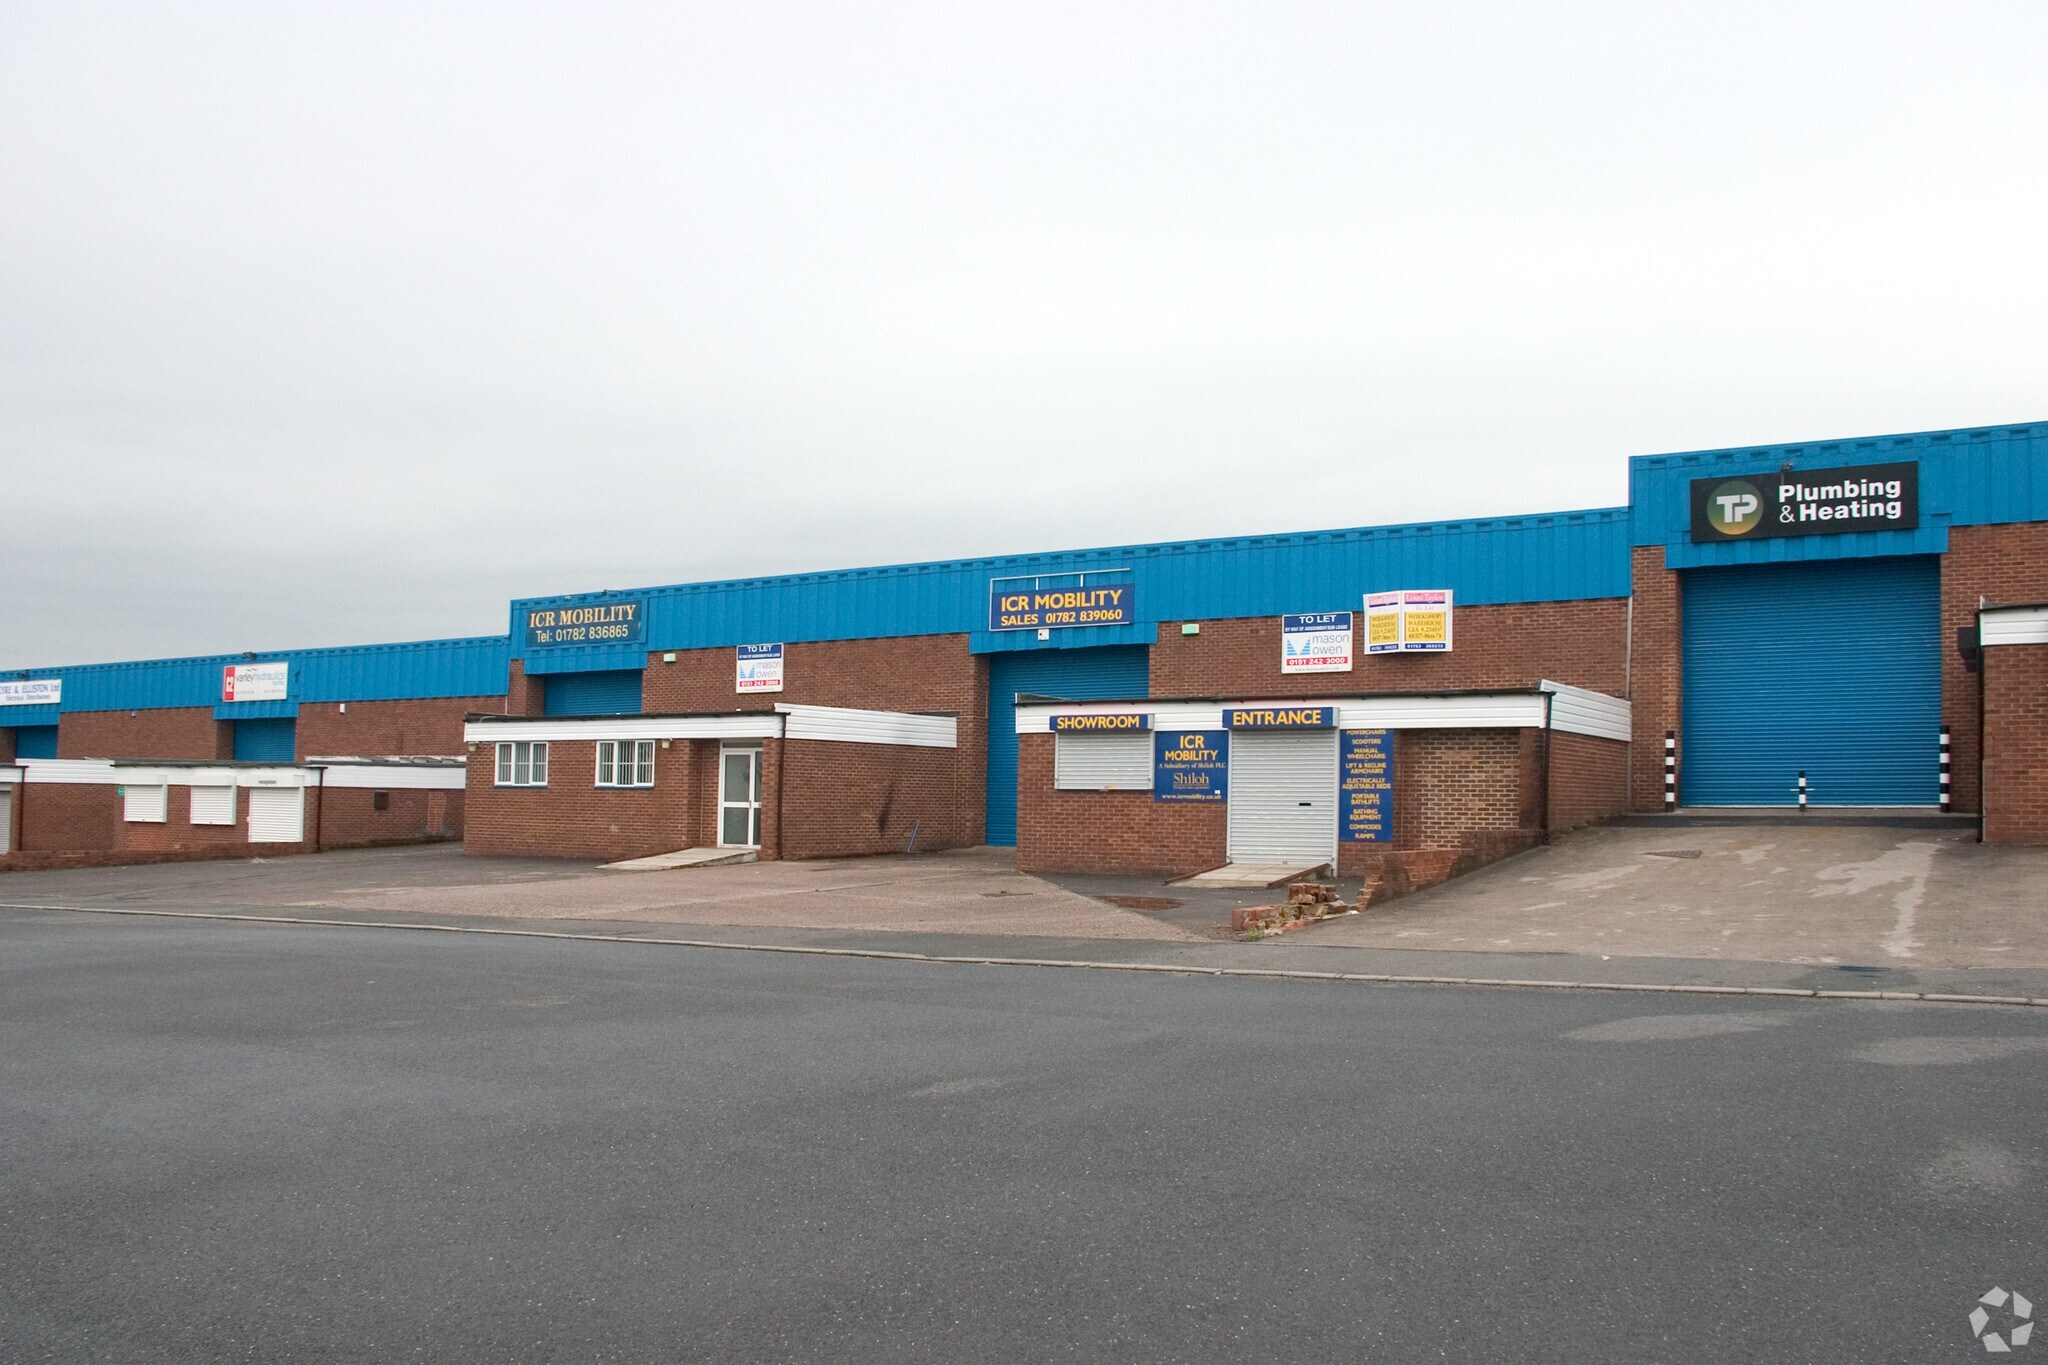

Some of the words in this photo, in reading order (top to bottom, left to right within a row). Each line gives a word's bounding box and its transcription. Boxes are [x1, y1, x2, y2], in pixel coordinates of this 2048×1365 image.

[1778, 479, 1901, 503] Plumbing
[1716, 494, 1758, 523] TP
[1779, 505, 1795, 523] &
[1799, 499, 1902, 522] Heating
[1001, 595, 1029, 612] ICR
[1035, 589, 1123, 610] MOBILITY
[529, 609, 555, 628] ICR
[559, 604, 637, 626] MOBILITY
[1001, 613, 1038, 626] SALES
[1045, 611, 1076, 624] 01782
[1080, 609, 1123, 622] 839060
[1299, 616, 1314, 624] TO
[1317, 614, 1337, 623] LET
[536, 629, 553, 643] Tel:
[555, 627, 586, 642] 01782
[589, 624, 629, 640] 836865
[1312, 634, 1350, 644] mason
[1312, 646, 1342, 655] owen
[1056, 715, 1140, 730] SHOWROOM
[1232, 709, 1322, 726] ENTRANCE
[1180, 735, 1205, 749] ICR
[1164, 750, 1218, 761] MOBILITY
[1173, 772, 1210, 784] Shiloh
